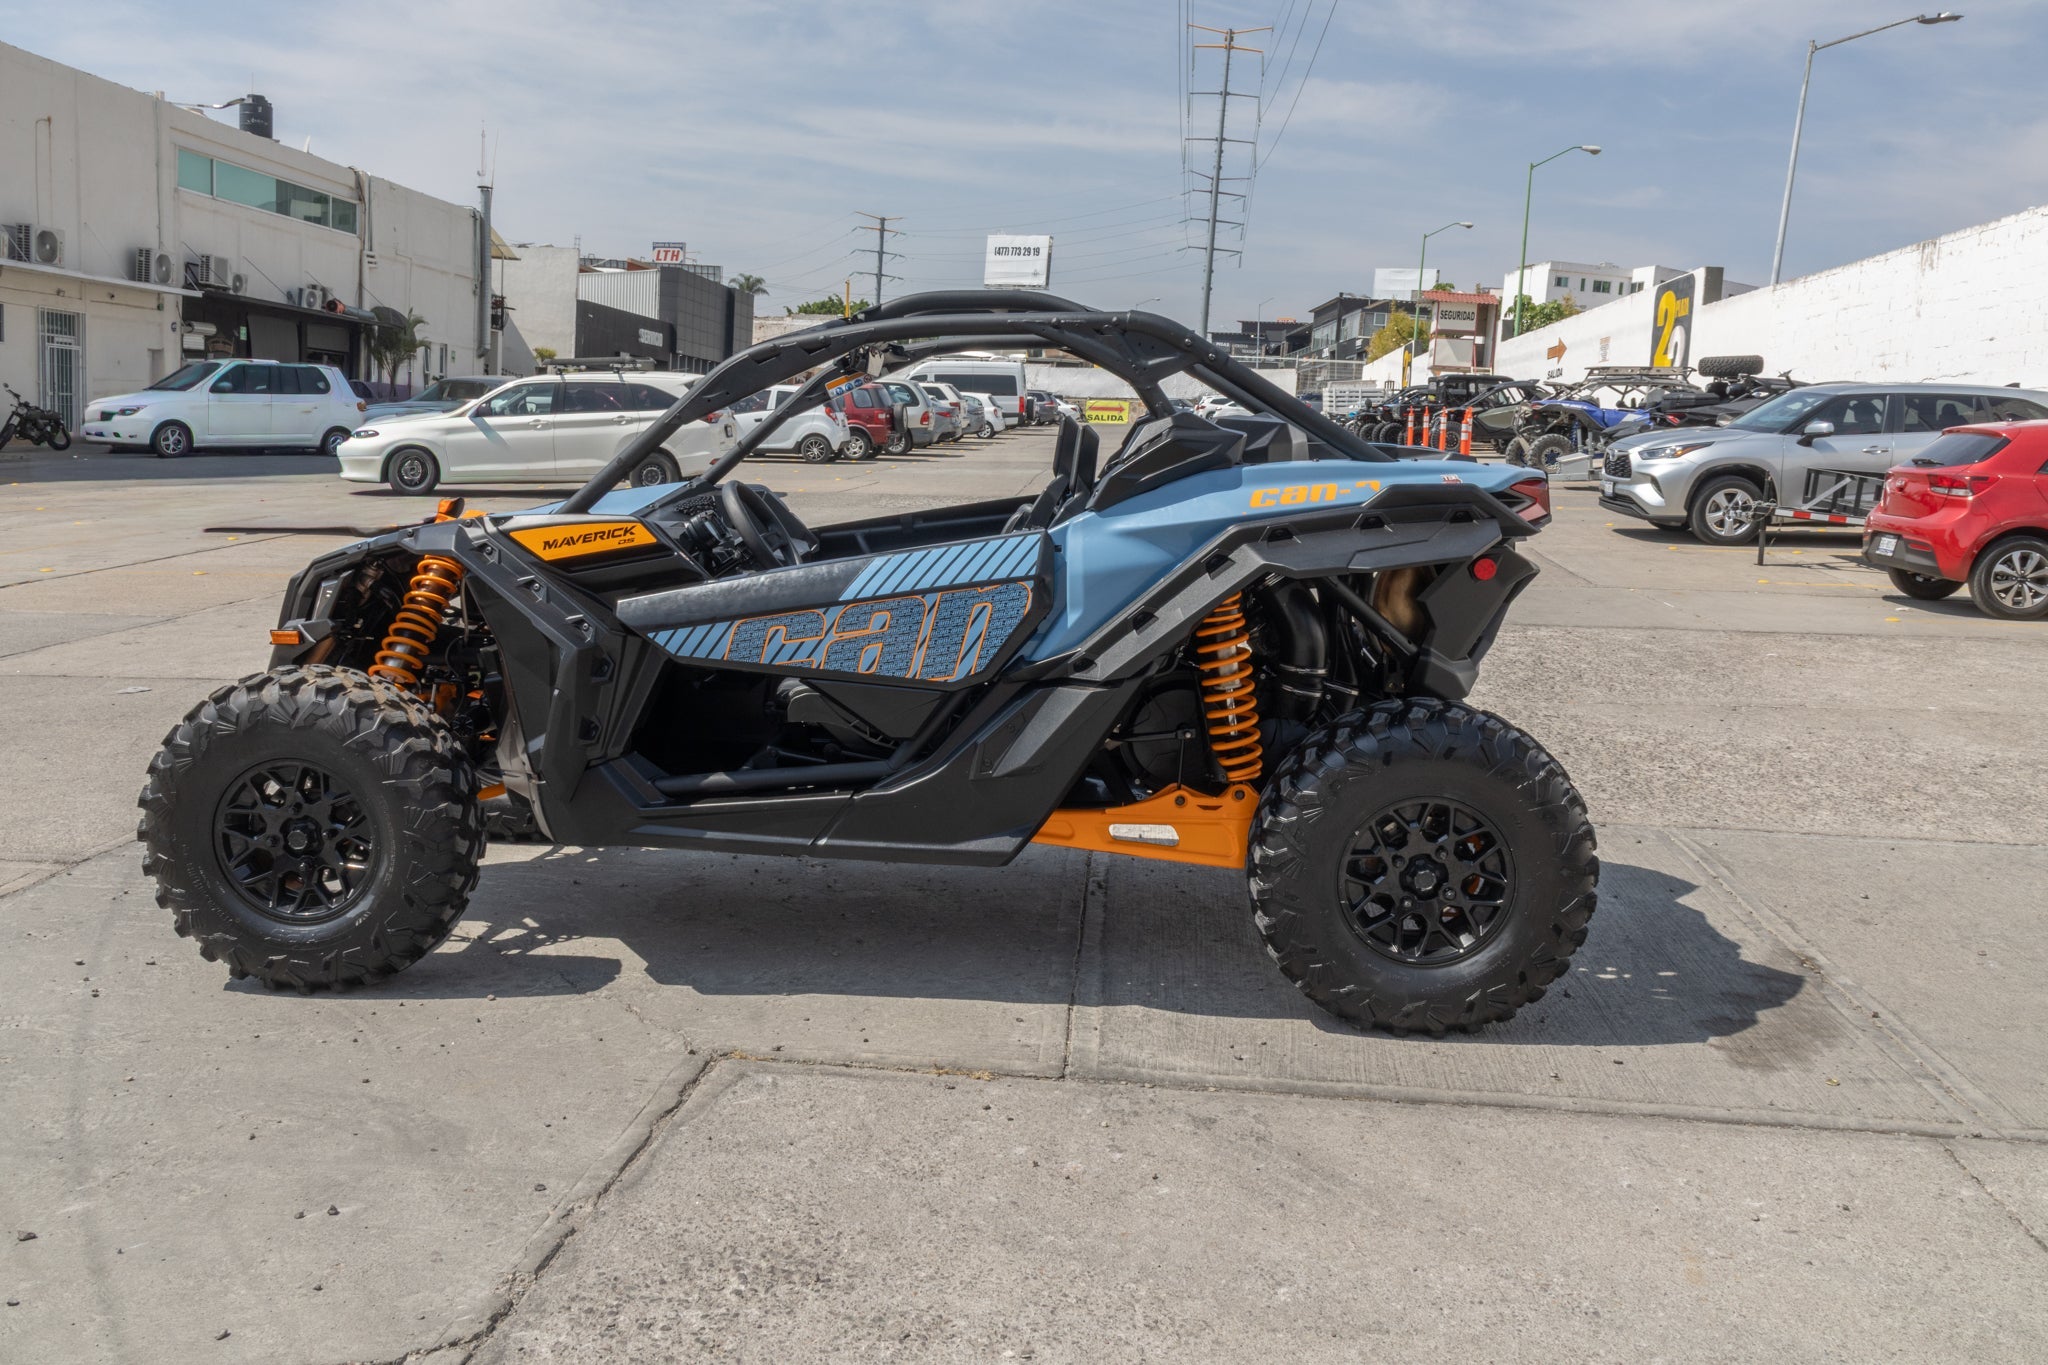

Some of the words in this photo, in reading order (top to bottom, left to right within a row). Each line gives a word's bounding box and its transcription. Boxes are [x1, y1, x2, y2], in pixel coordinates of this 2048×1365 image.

[656, 249, 681, 261] LTH
[994, 246, 1010, 256] (477)
[1010, 246, 1022, 256] 773
[1022, 246, 1032, 256] 29
[1032, 246, 1040, 256] 19
[1440, 310, 1475, 321] SEGURIDAD
[1087, 414, 1124, 422] SALIDA
[542, 525, 637, 551] MAVERICK
